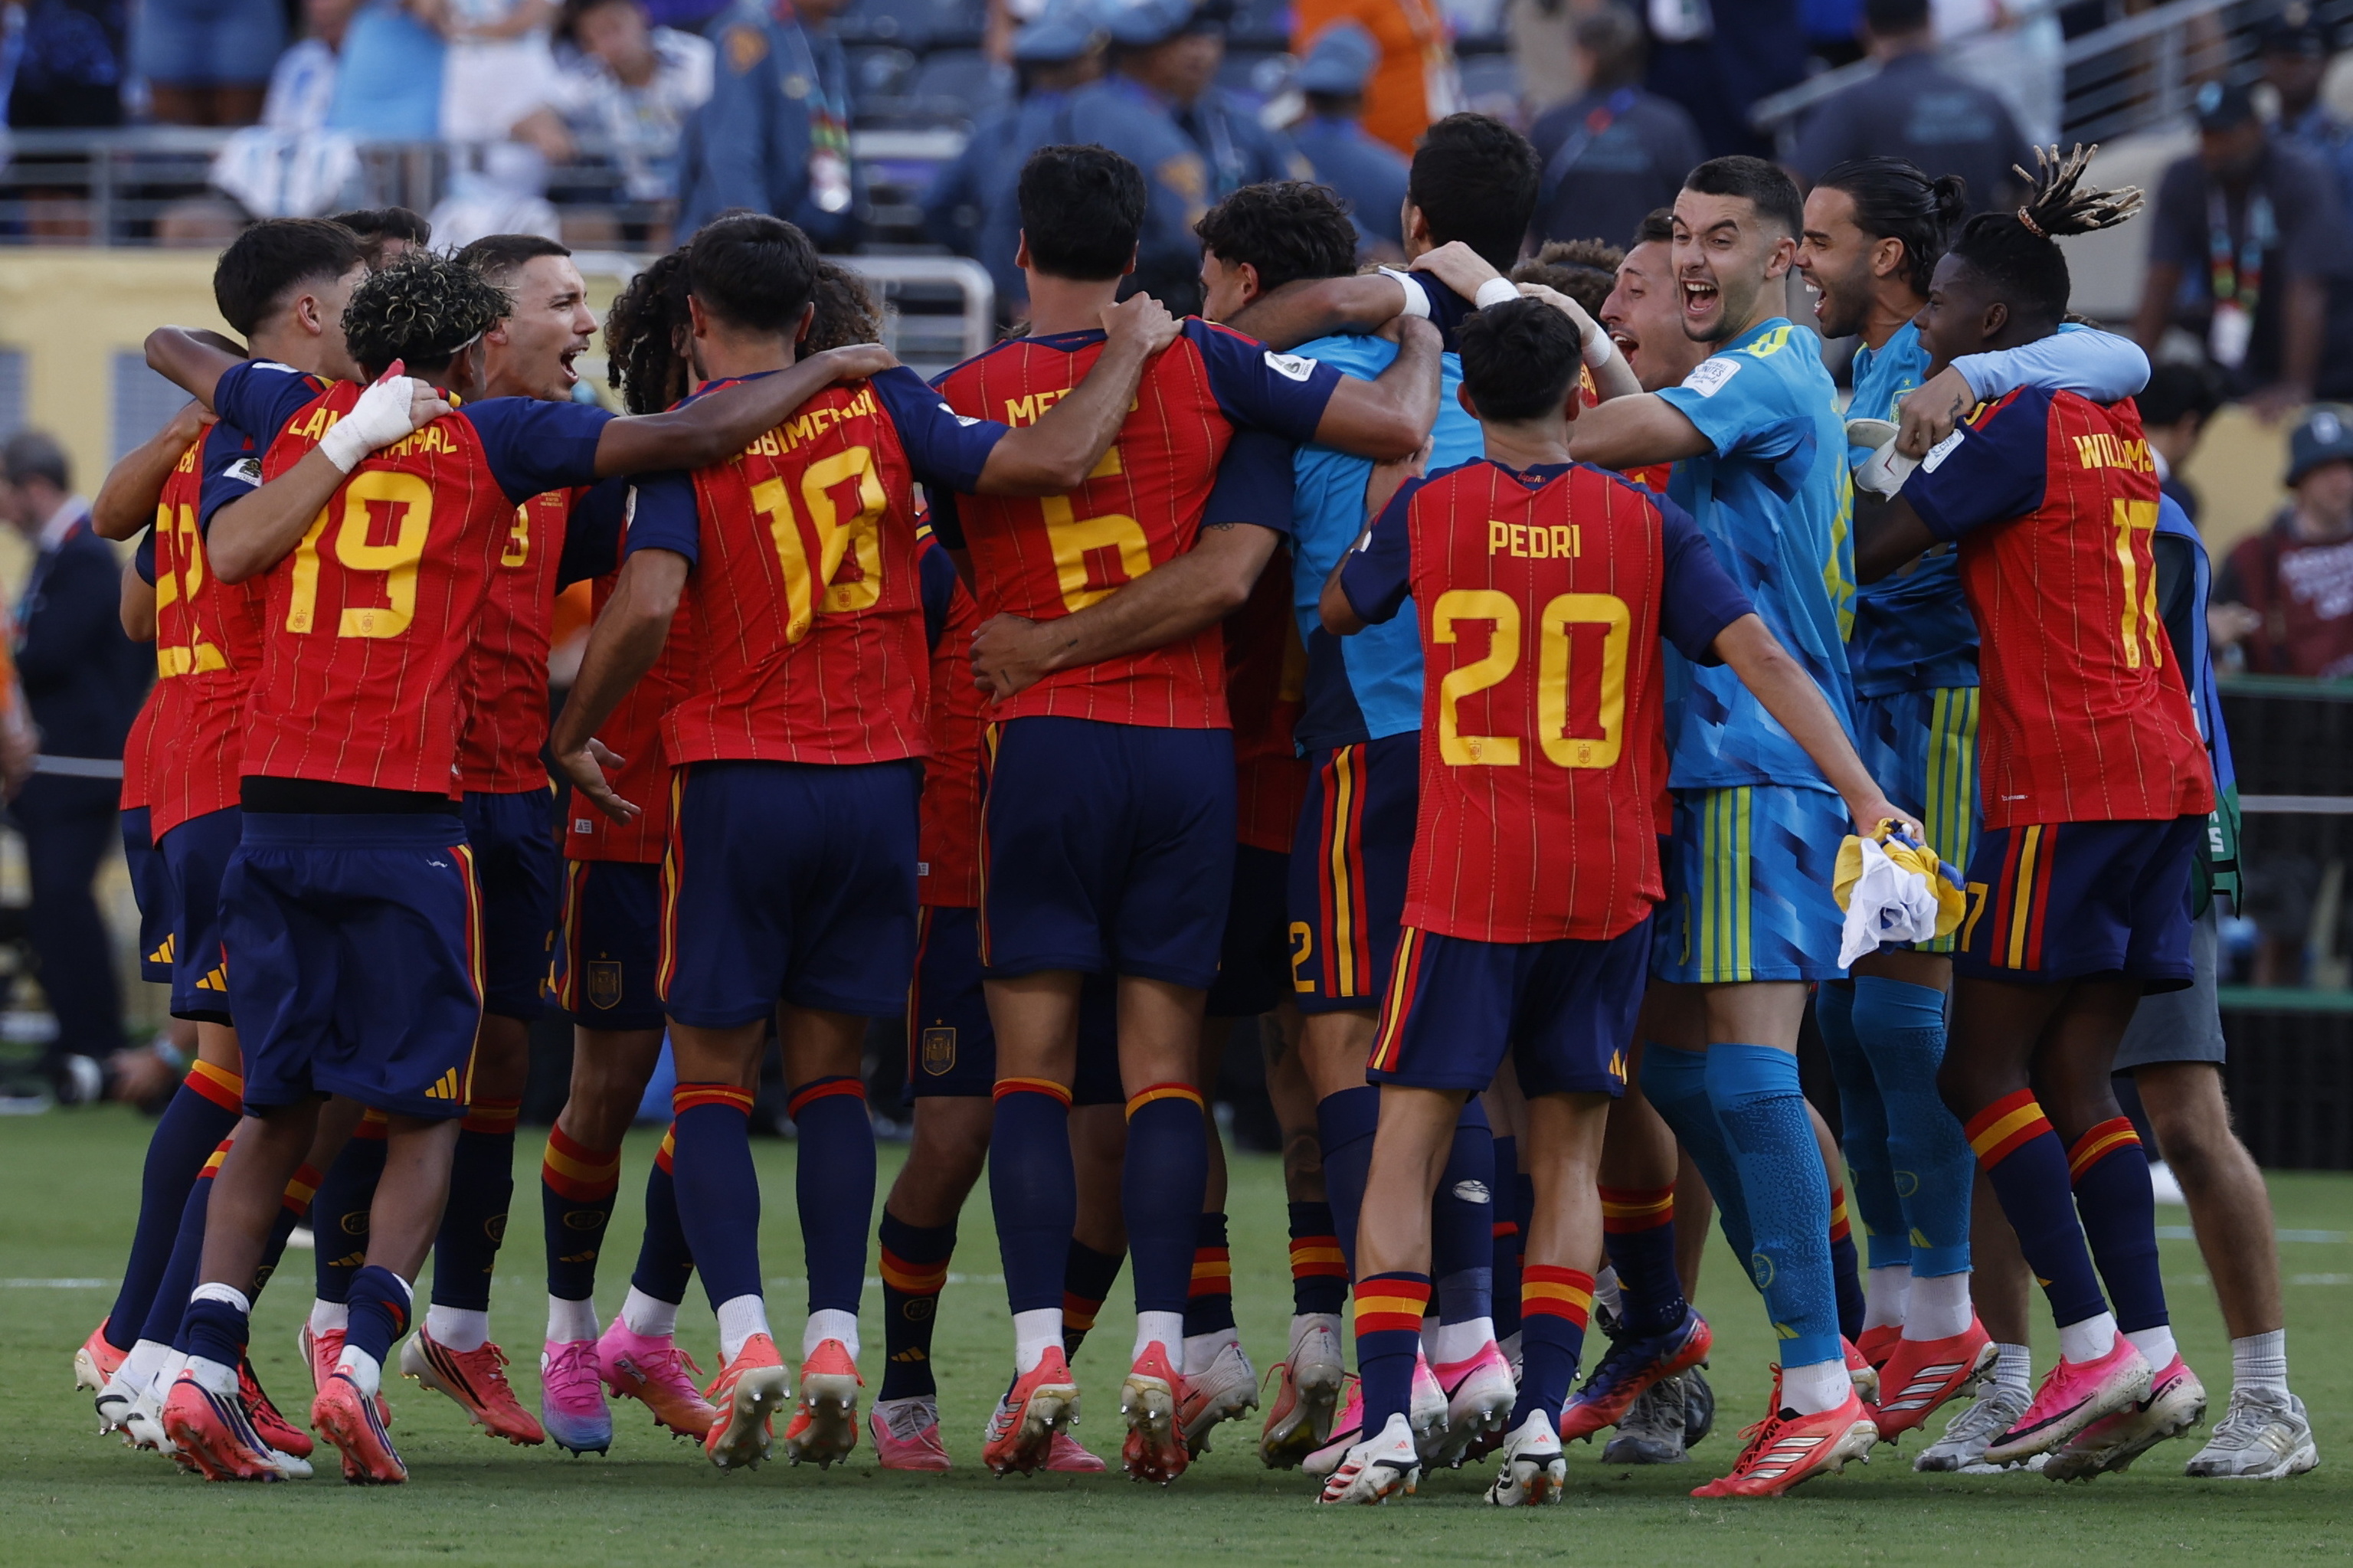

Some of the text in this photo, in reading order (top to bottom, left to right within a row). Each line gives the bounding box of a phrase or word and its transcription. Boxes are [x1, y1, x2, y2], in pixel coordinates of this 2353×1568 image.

[727, 389, 877, 465] UBIMENDI
[156, 502, 227, 679] 22
[285, 472, 434, 638] 19
[750, 445, 887, 646] 18
[1042, 446, 1153, 613] 6
[1487, 521, 1582, 558] PEDRI
[2112, 498, 2162, 669] 17
[1432, 589, 1631, 768] 20
[1290, 921, 1315, 993] 2
